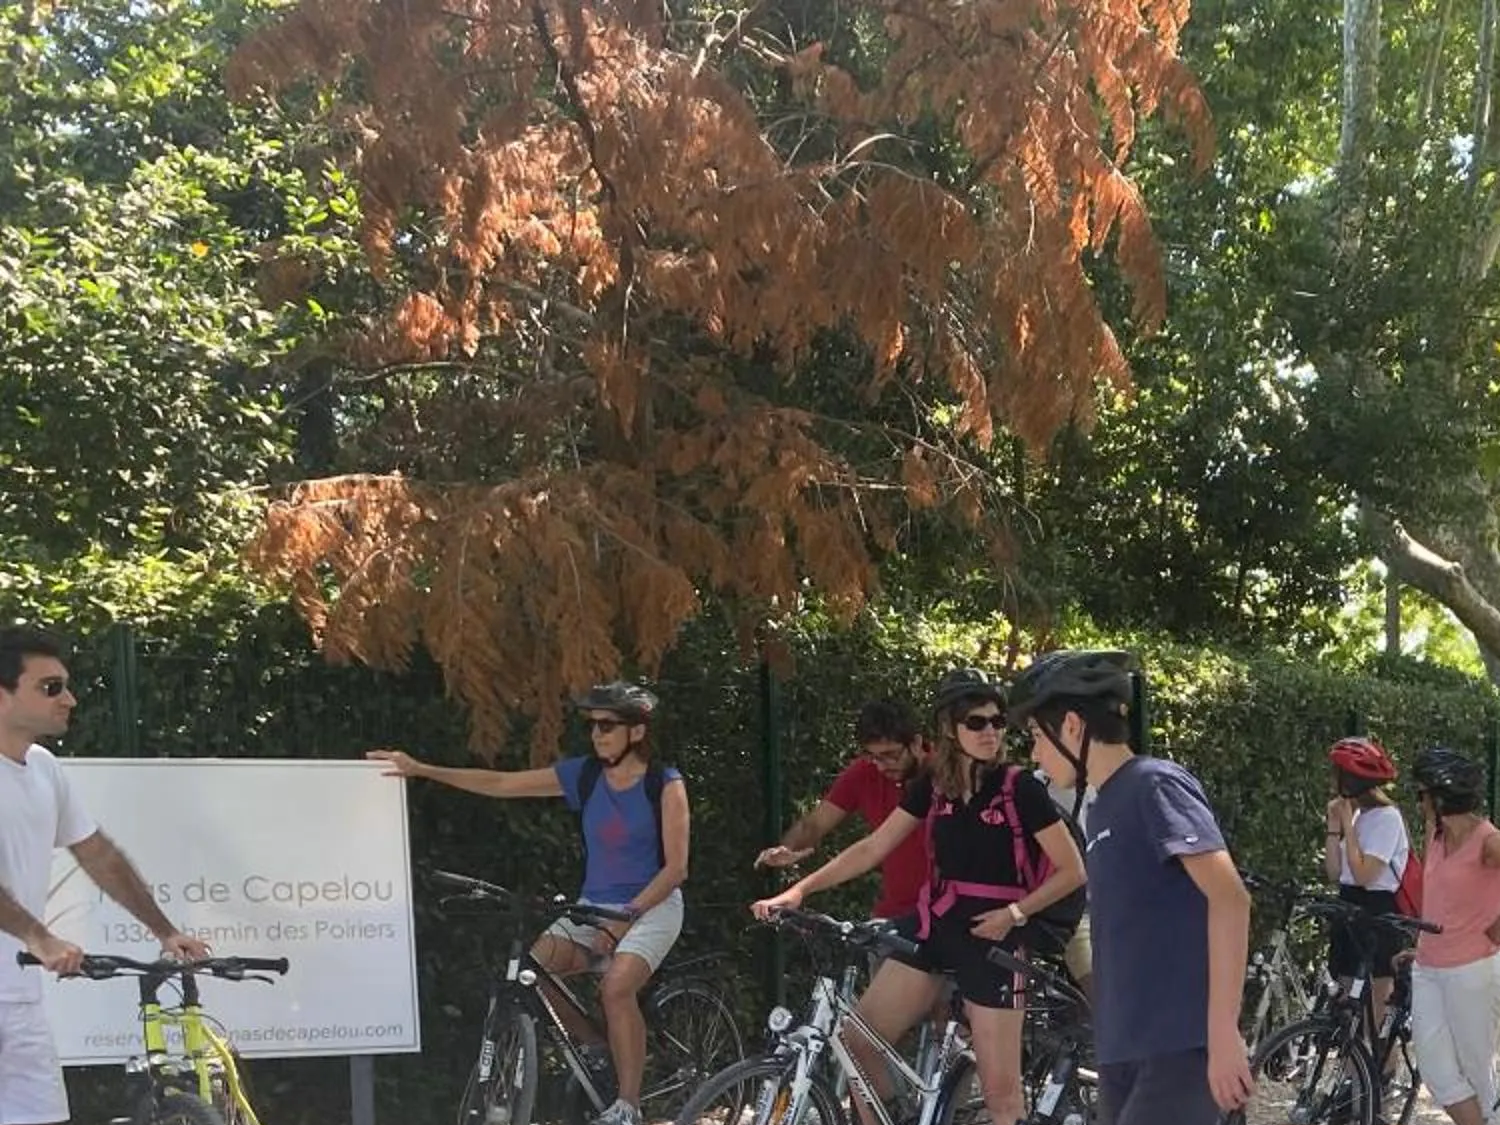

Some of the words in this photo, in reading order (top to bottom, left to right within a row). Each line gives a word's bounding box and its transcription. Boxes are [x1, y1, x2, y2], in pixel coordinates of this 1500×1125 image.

[183, 877, 231, 903] de
[243, 873, 393, 908] Capelou
[180, 920, 259, 943] hemin
[266, 920, 308, 942] des
[315, 919, 396, 940] Poiriers
